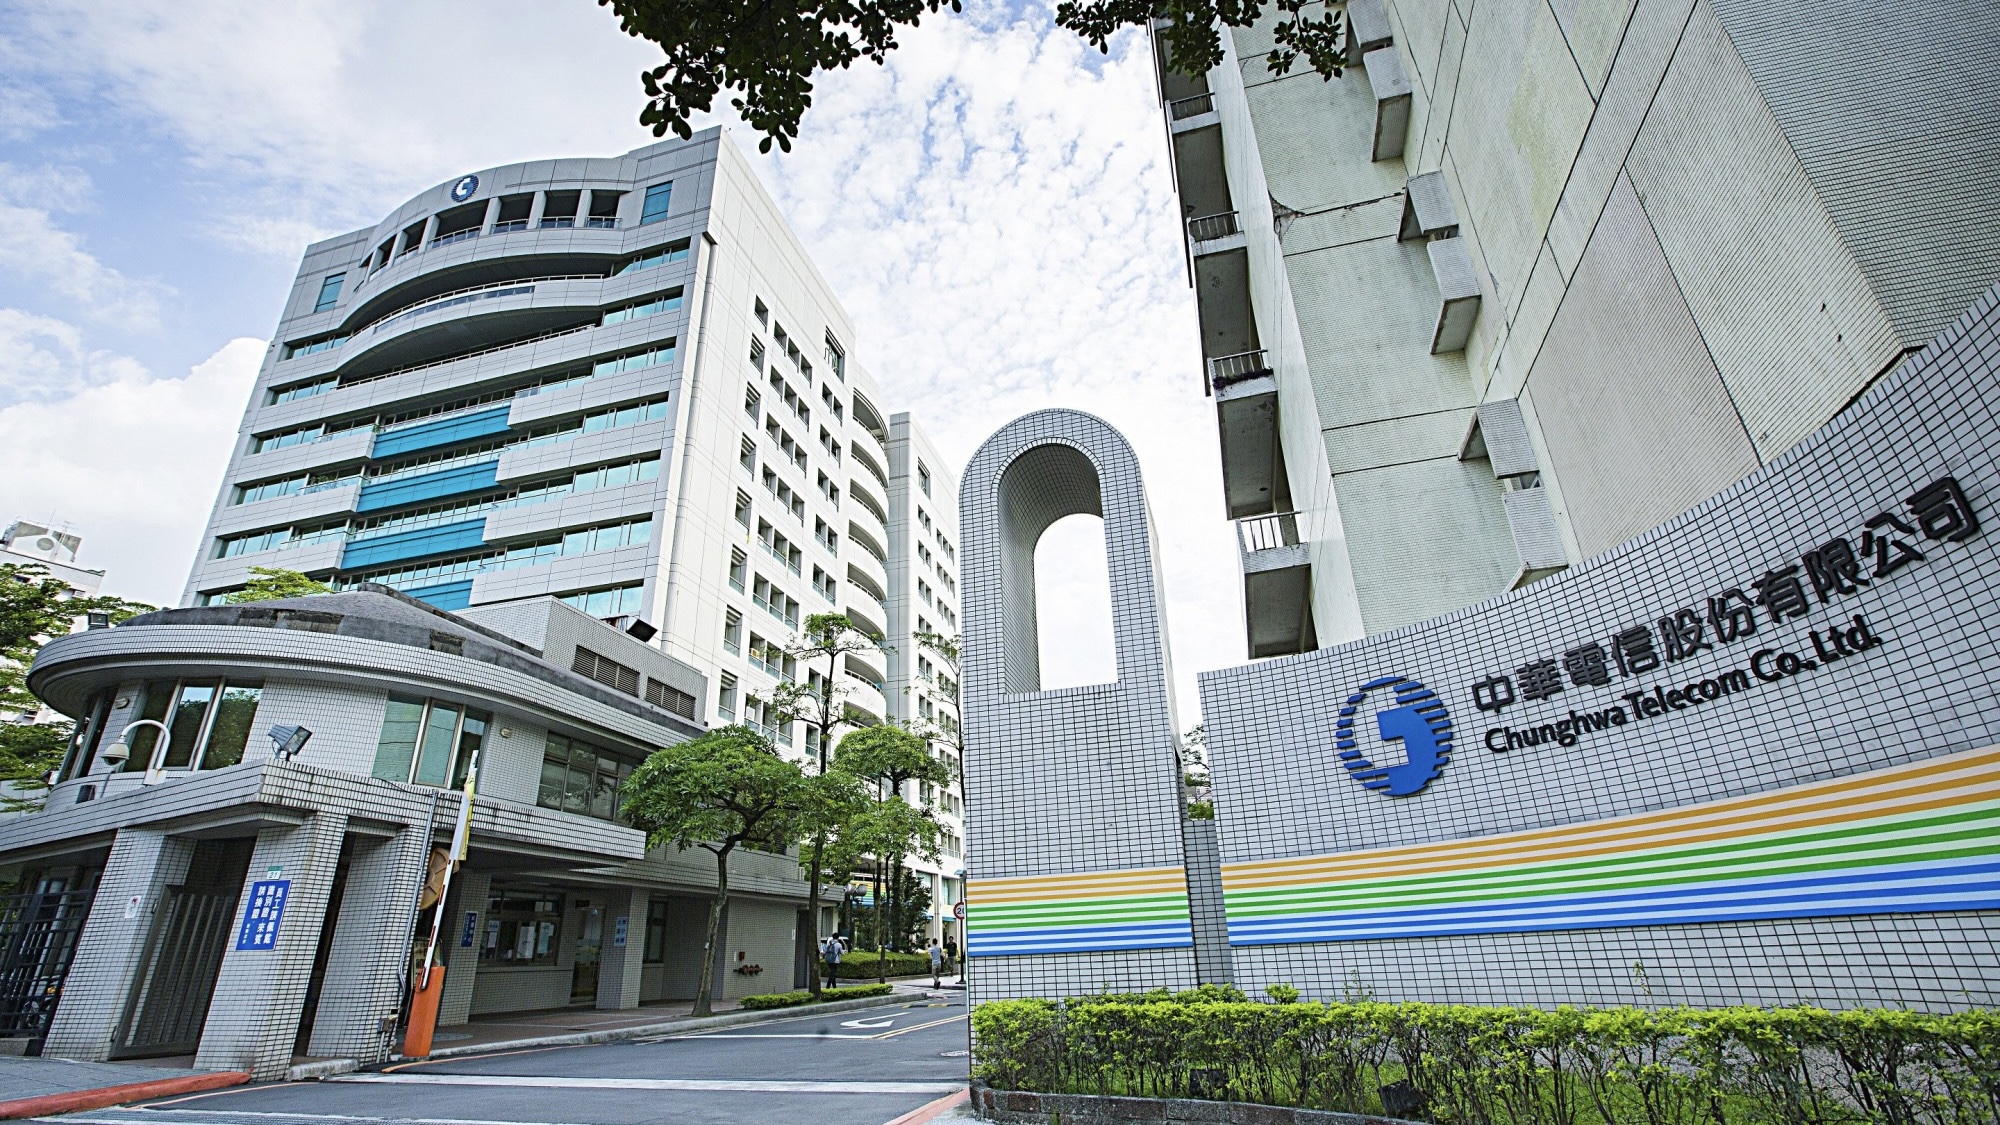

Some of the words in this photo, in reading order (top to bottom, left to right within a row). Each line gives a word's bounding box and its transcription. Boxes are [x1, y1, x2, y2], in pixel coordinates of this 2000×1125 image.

[1471, 476, 1979, 713] 中華電信股份有限公司
[1485, 705, 1627, 754] Chunghwa
[1621, 668, 1750, 720] Telecom
